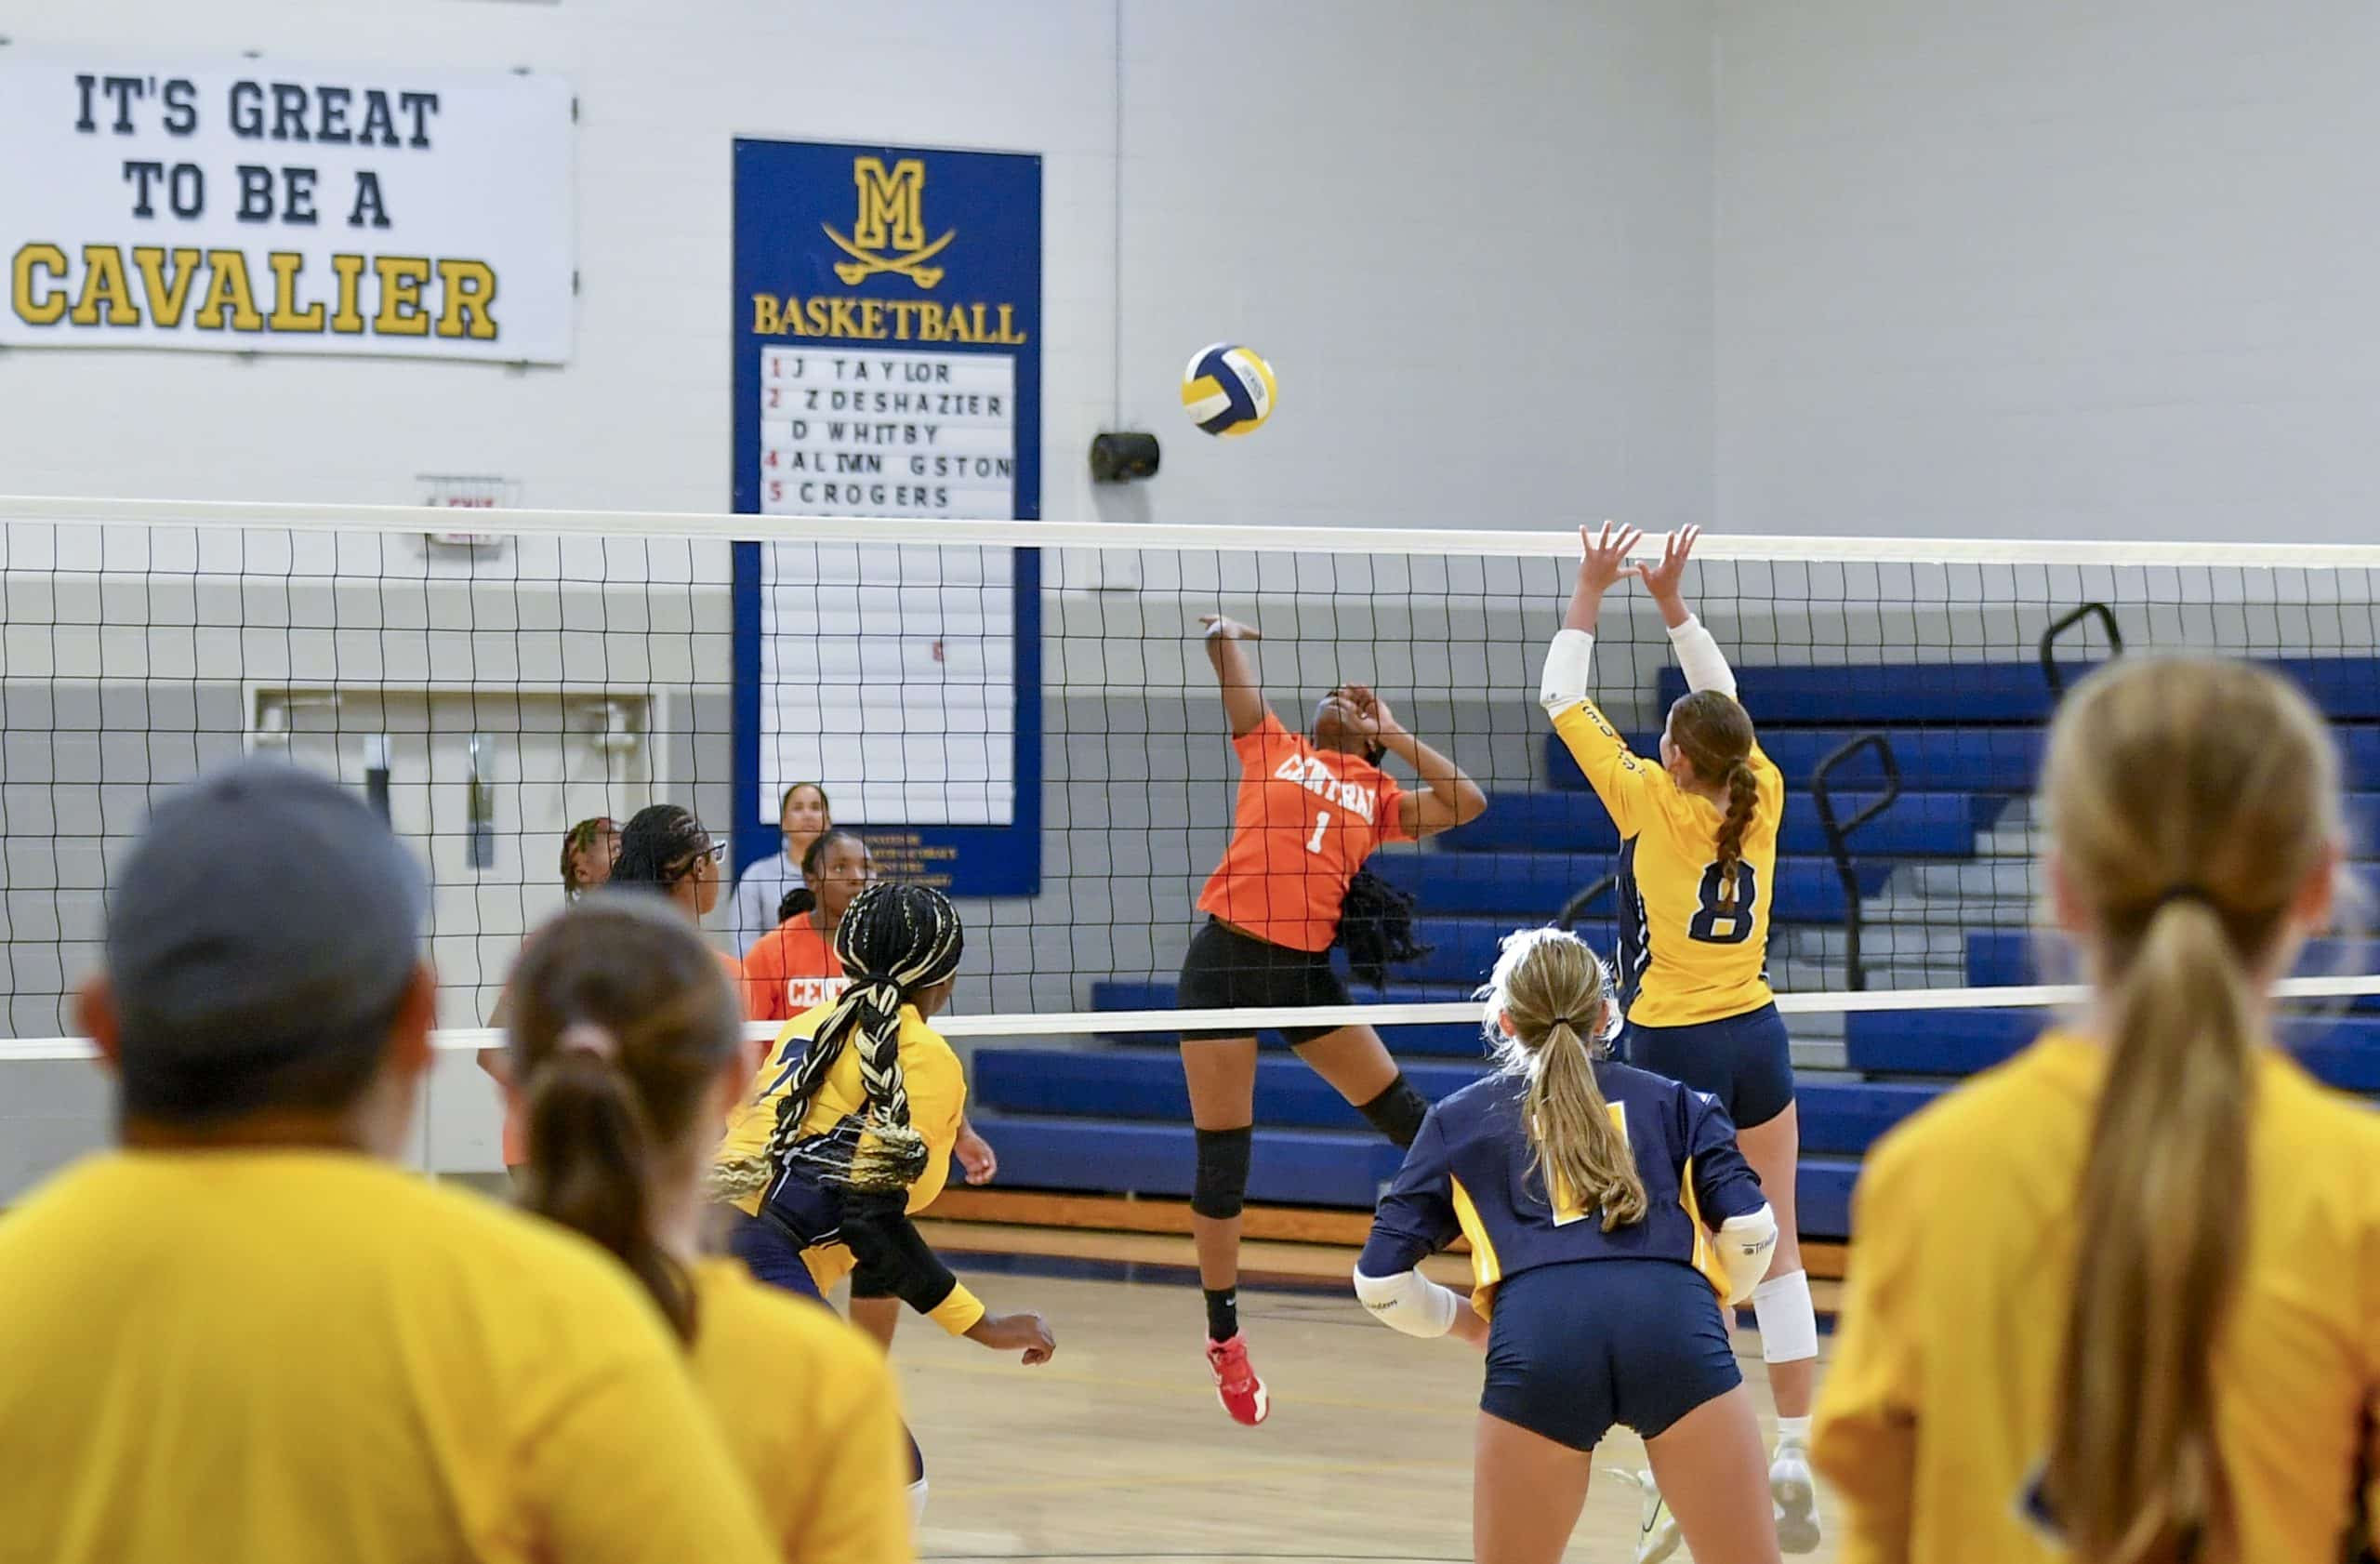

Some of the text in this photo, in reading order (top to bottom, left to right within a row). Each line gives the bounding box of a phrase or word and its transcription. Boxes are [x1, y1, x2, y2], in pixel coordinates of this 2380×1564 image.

[74, 74, 439, 149] IT'S GREAT
[124, 160, 391, 228] TO BE A
[853, 155, 925, 251] M
[11, 242, 498, 340] CAVALIER
[752, 295, 1027, 344] BASKETBALL
[773, 358, 950, 383] 1 J TAYLOR
[768, 388, 780, 409] 2
[792, 420, 938, 444] D WHITBY
[764, 450, 779, 469] 4
[1305, 810, 1331, 854] 1
[1687, 858, 1757, 945] 8
